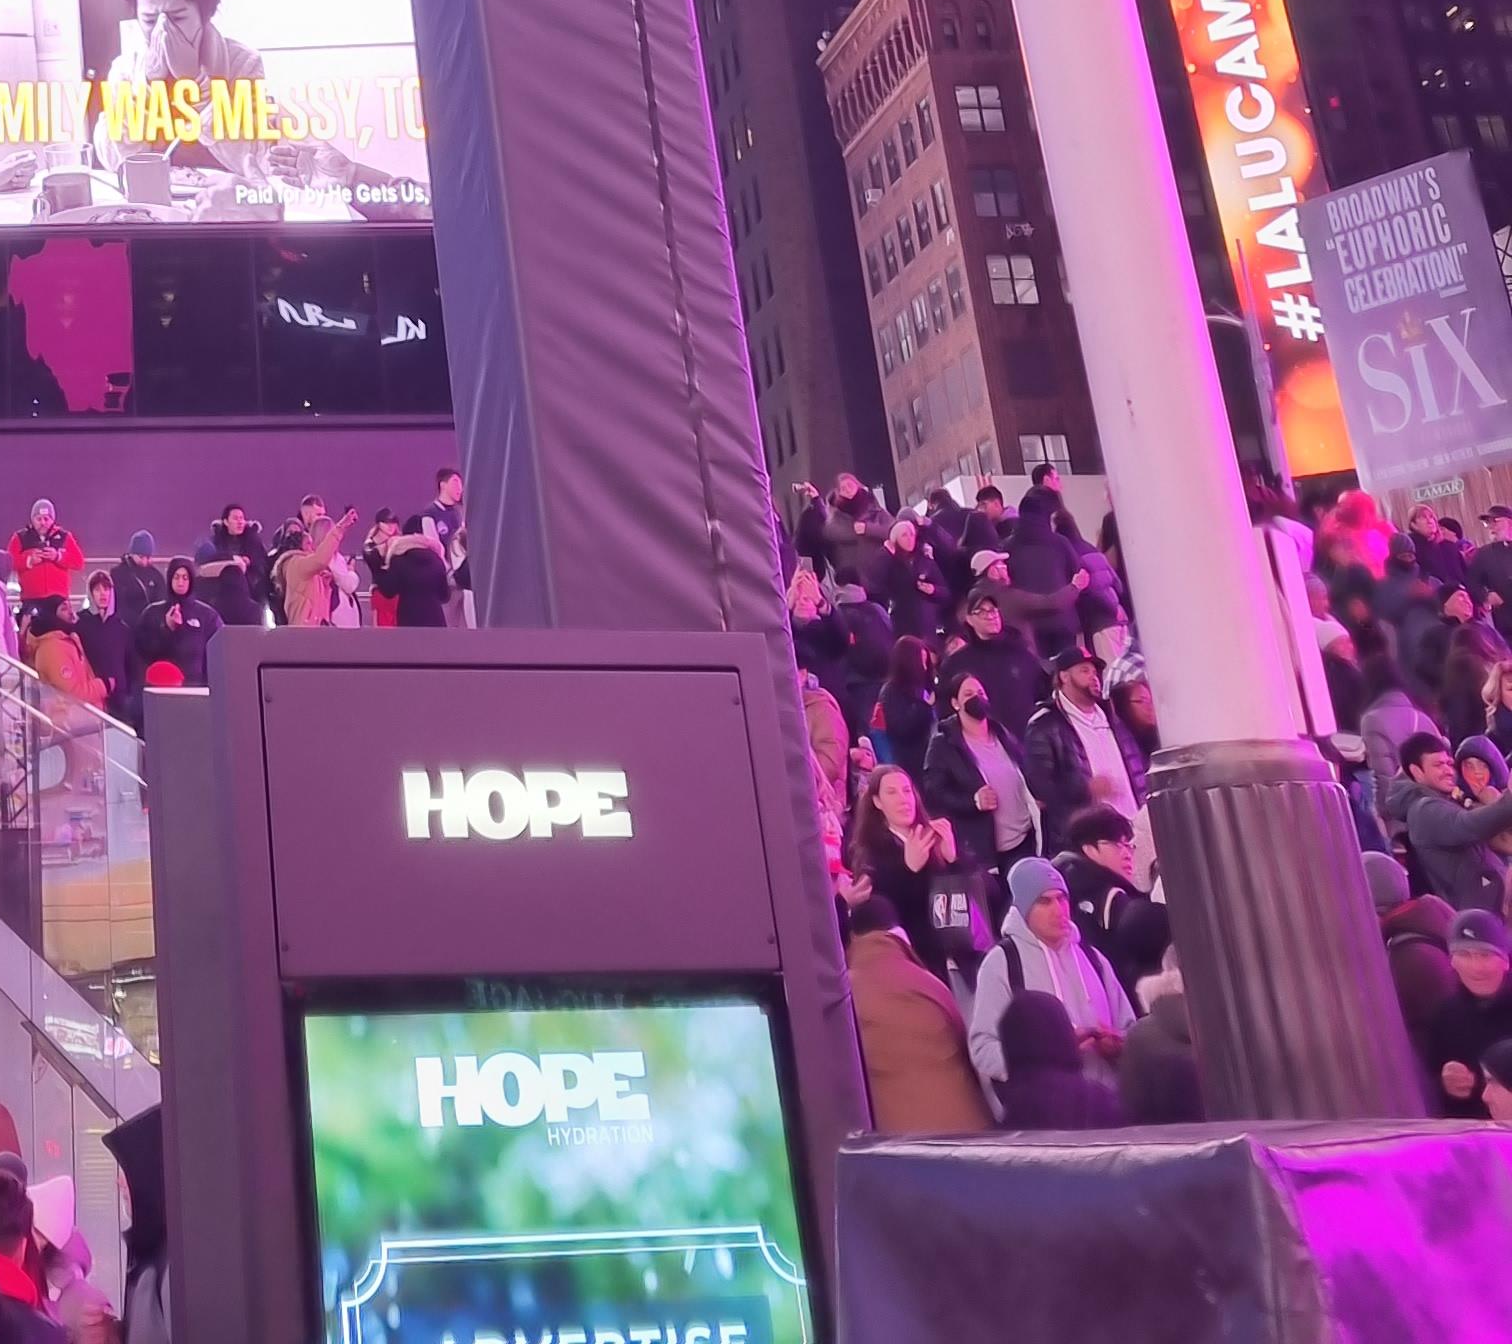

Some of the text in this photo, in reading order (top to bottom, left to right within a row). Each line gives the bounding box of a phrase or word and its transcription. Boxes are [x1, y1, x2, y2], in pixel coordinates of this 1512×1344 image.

[100, 78, 203, 143] WAS
[210, 76, 375, 149] MESSY,
[236, 185, 273, 204] Paid
[277, 185, 299, 204] for
[305, 185, 326, 208] by
[326, 184, 352, 204] He
[356, 184, 397, 205] Gets
[1326, 166, 1441, 235] BROADWAY'S
[1415, 478, 1459, 500] LAMAR
[402, 768, 634, 841] HOPE
[415, 1051, 652, 1128] HOPE
[548, 1125, 654, 1147] HYDRATION
